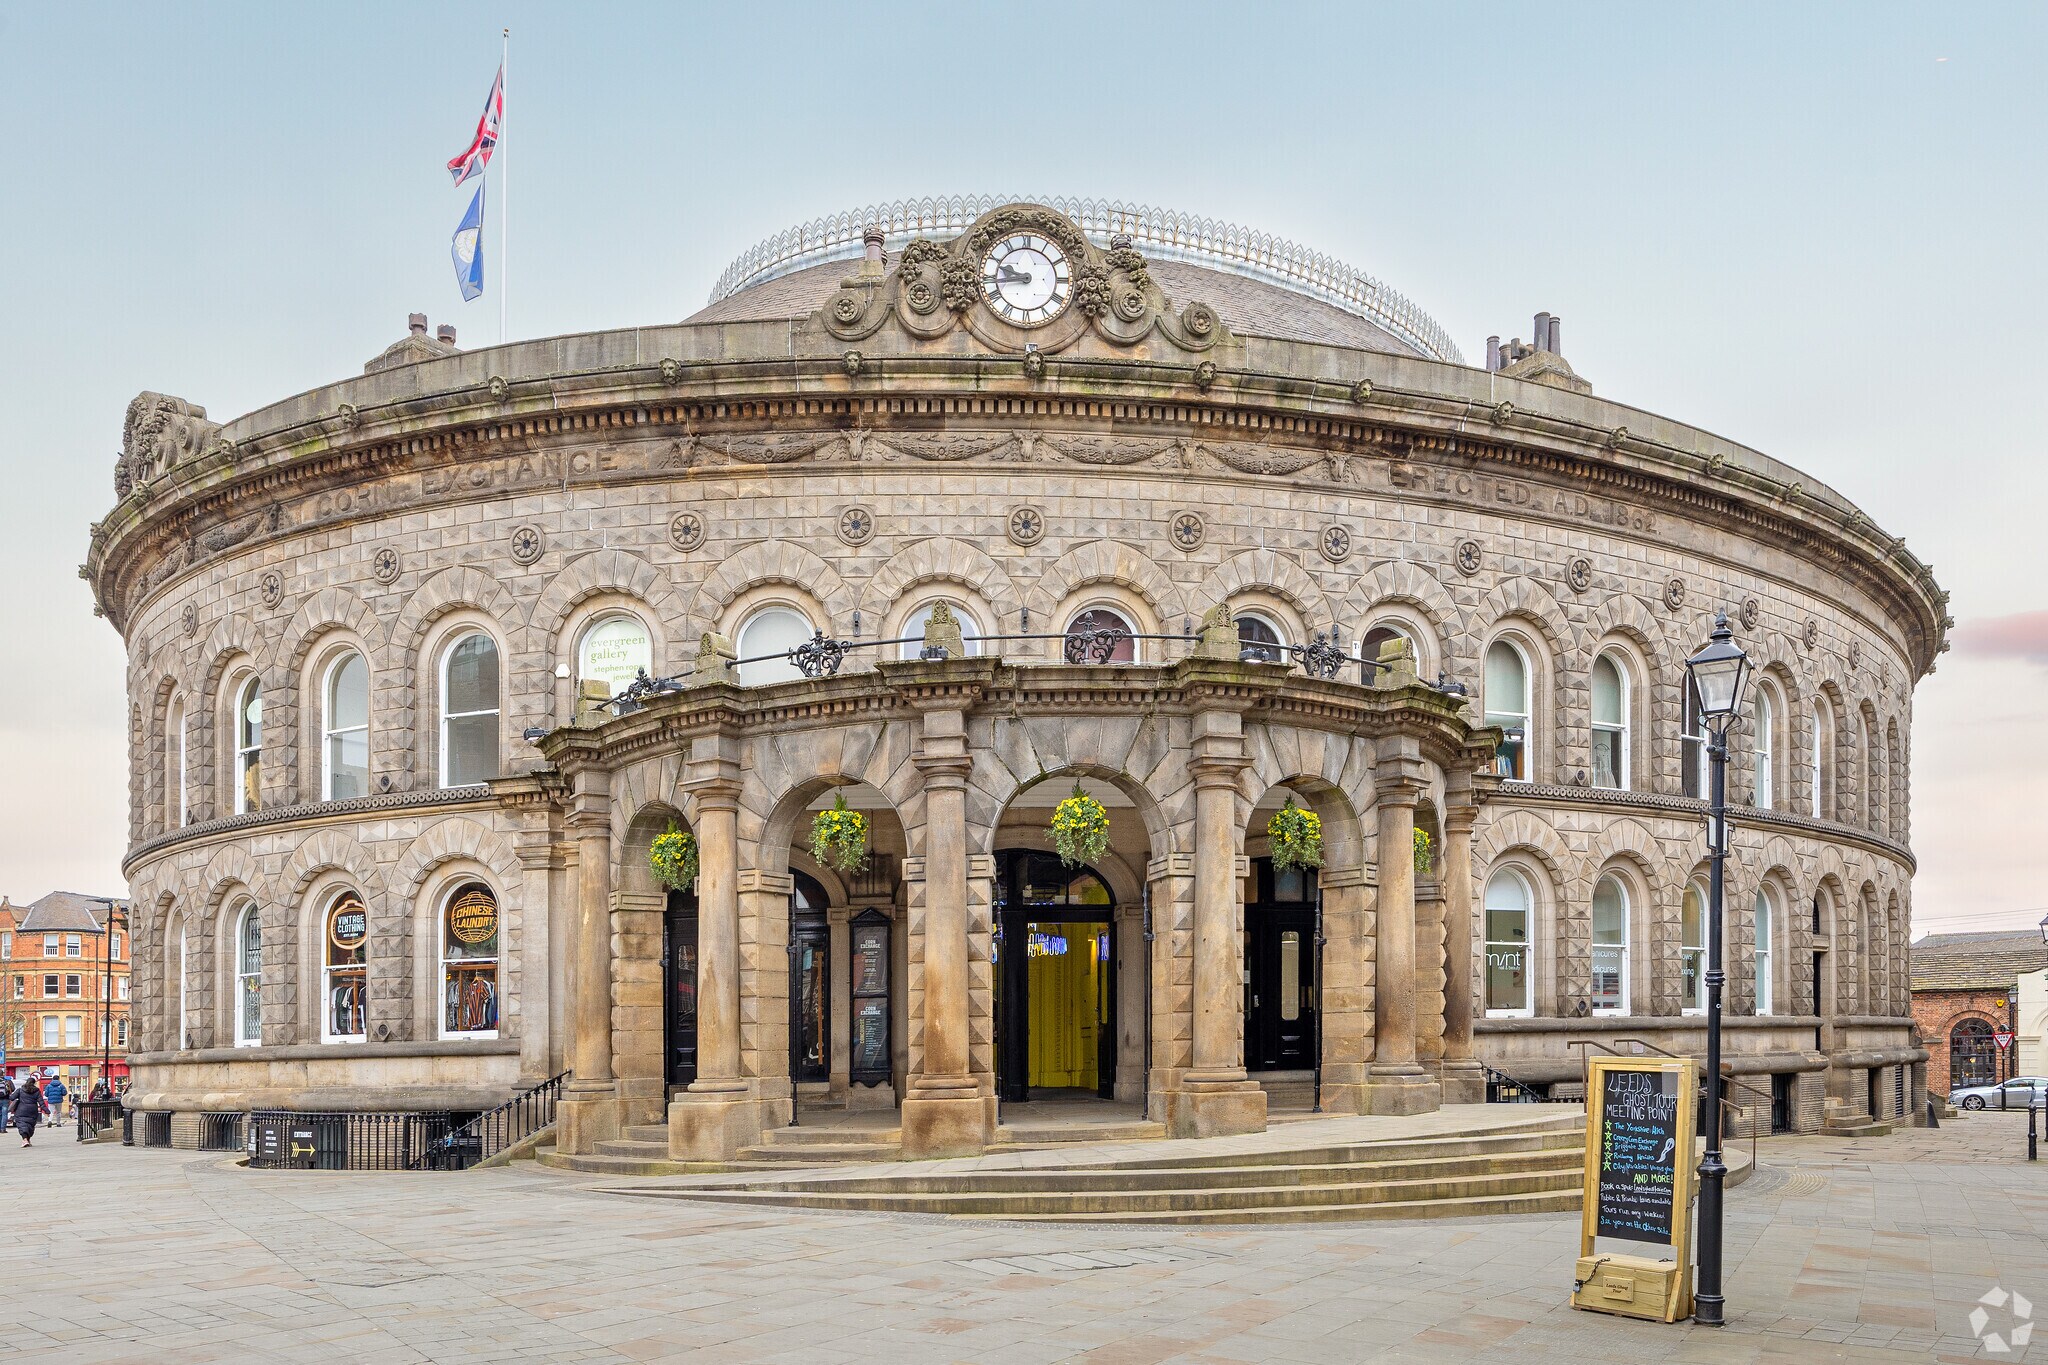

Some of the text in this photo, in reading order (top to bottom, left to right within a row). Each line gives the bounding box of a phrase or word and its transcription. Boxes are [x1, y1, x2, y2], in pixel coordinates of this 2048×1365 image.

[317, 446, 618, 517] CORN EXCHANGE
[591, 637, 645, 649] evergreen
[590, 648, 628, 664] gallery
[594, 665, 624, 674] stephen
[456, 905, 494, 918] CHINESE
[338, 915, 364, 925] VINTAGE
[456, 916, 494, 928] LAUNDRY
[338, 923, 365, 933] CLOTHING
[1608, 1072, 1652, 1094] LEEDS
[1623, 1092, 1678, 1111] GHOST TOUR
[1606, 1104, 1673, 1122] MEETING POINT
[1614, 1122, 1624, 1130] The
[1627, 1122, 1650, 1133] Yorkshire
[1638, 1137, 1658, 1146] Exchange
[1633, 1173, 1674, 1184] AND MORE!
[1600, 1182, 1615, 1192] Book
[1600, 1193, 1615, 1201] Public
[1602, 1204, 1617, 1213] Tours
[1600, 1216, 1612, 1225] See
[1613, 1219, 1624, 1229] you
